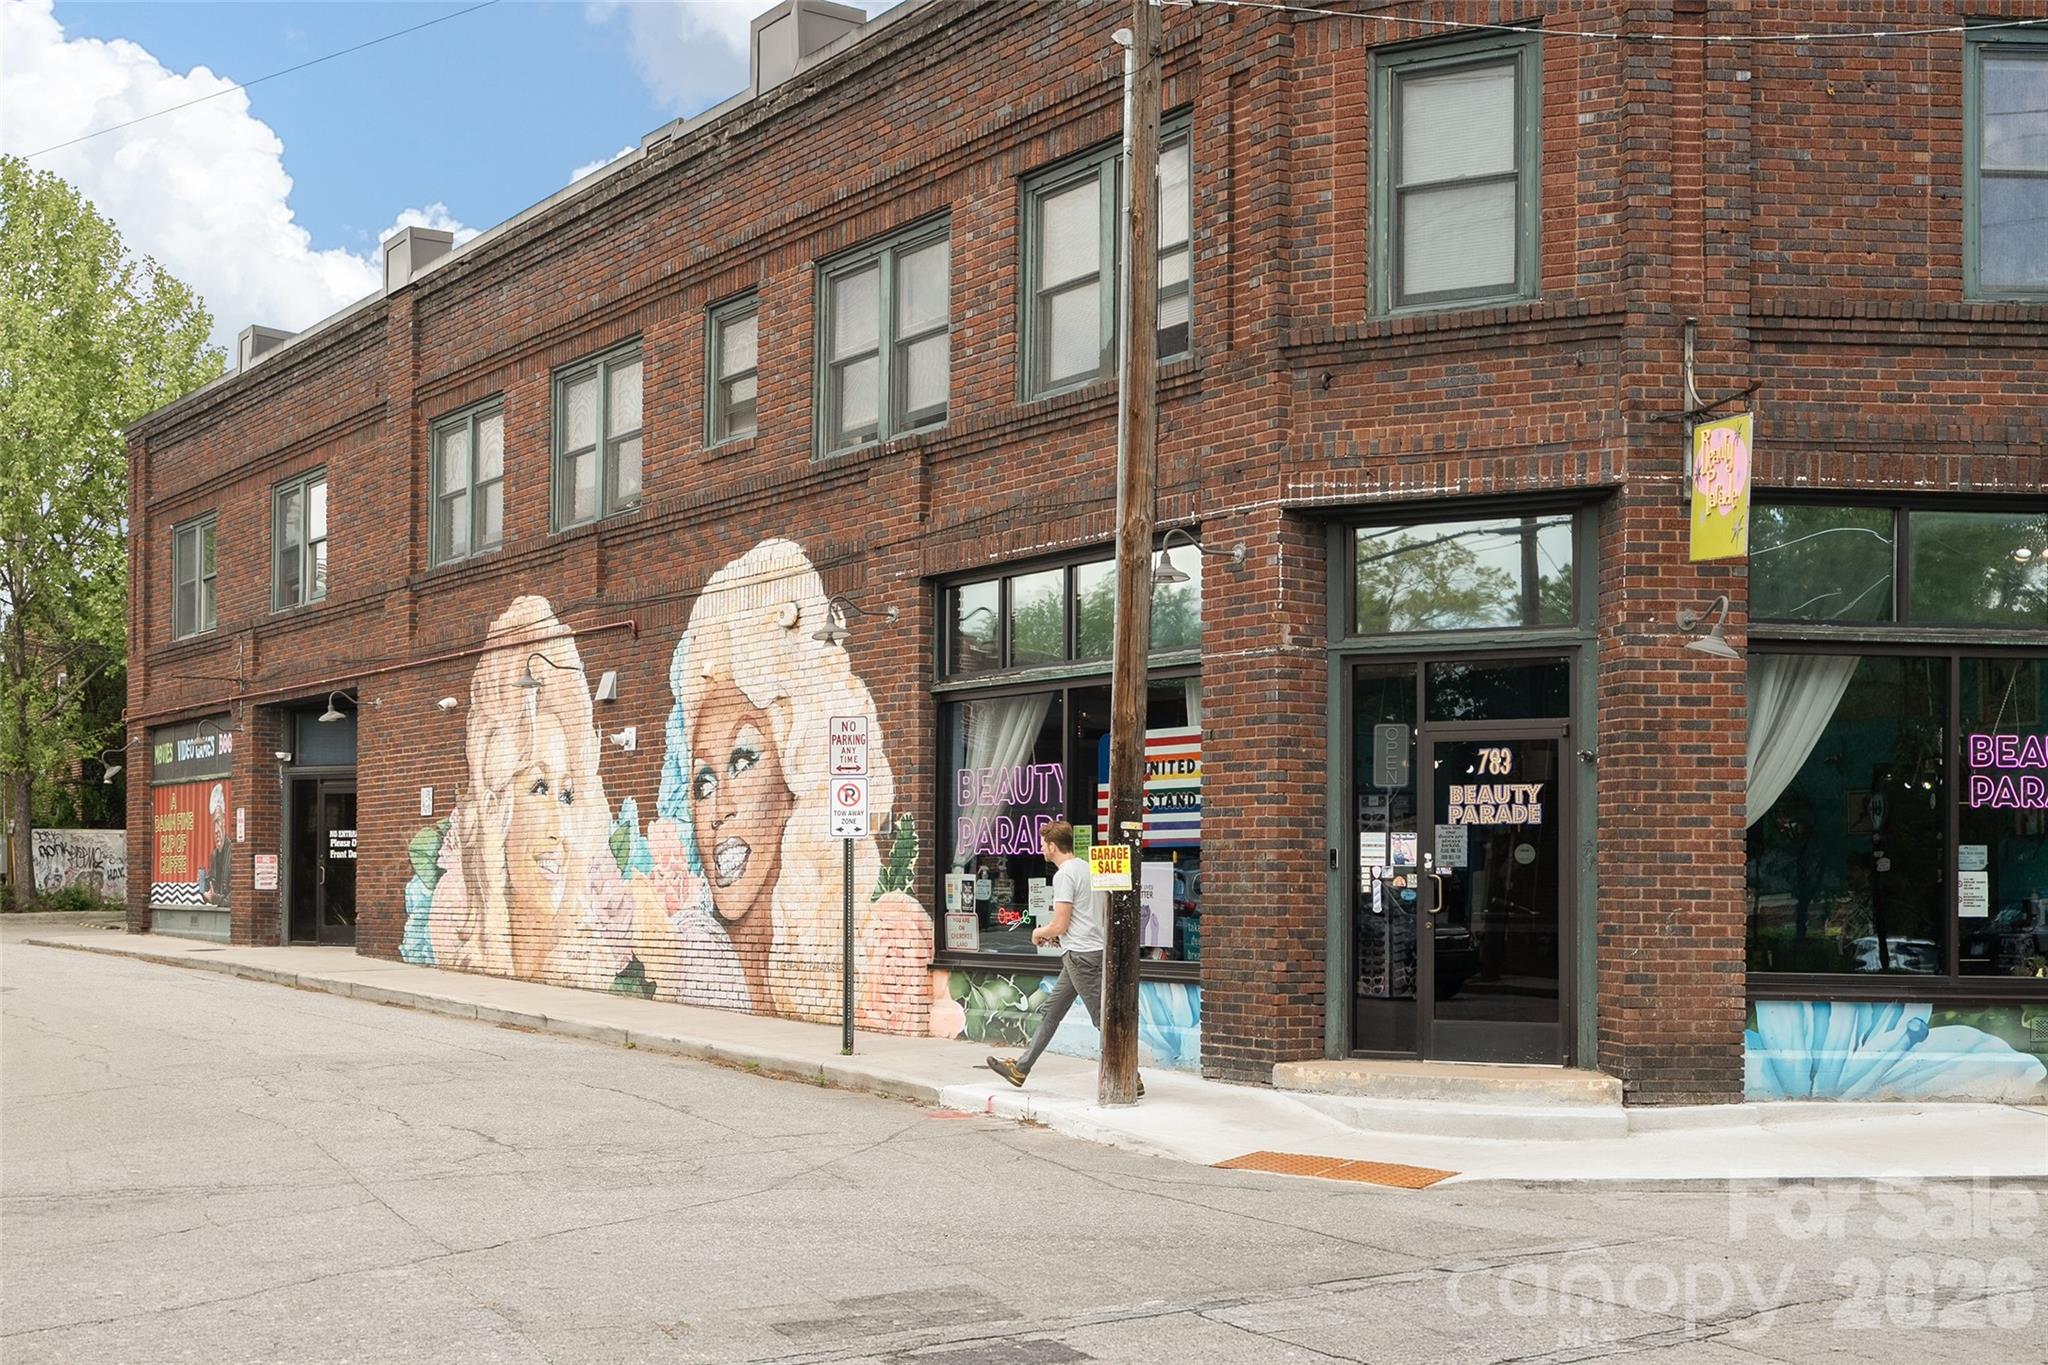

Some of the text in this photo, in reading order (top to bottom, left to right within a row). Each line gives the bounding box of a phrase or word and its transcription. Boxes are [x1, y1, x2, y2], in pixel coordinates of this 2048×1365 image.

[841, 721, 856, 732] NO
[831, 734, 866, 745] PARKING
[840, 755, 858, 763] TIME
[1385, 727, 1398, 784] OPEN
[1970, 734, 2048, 768] BEA
[1477, 747, 1513, 775] 783
[1146, 791, 1196, 810] STAND
[1449, 783, 1544, 805] BEAUTY
[1970, 775, 2048, 808] PAR
[170, 792, 176, 810] A
[1448, 803, 1542, 825] PARADE
[330, 850, 347, 858] Front
[1091, 847, 1129, 860] GARAGE
[1098, 860, 1123, 874] SALE
